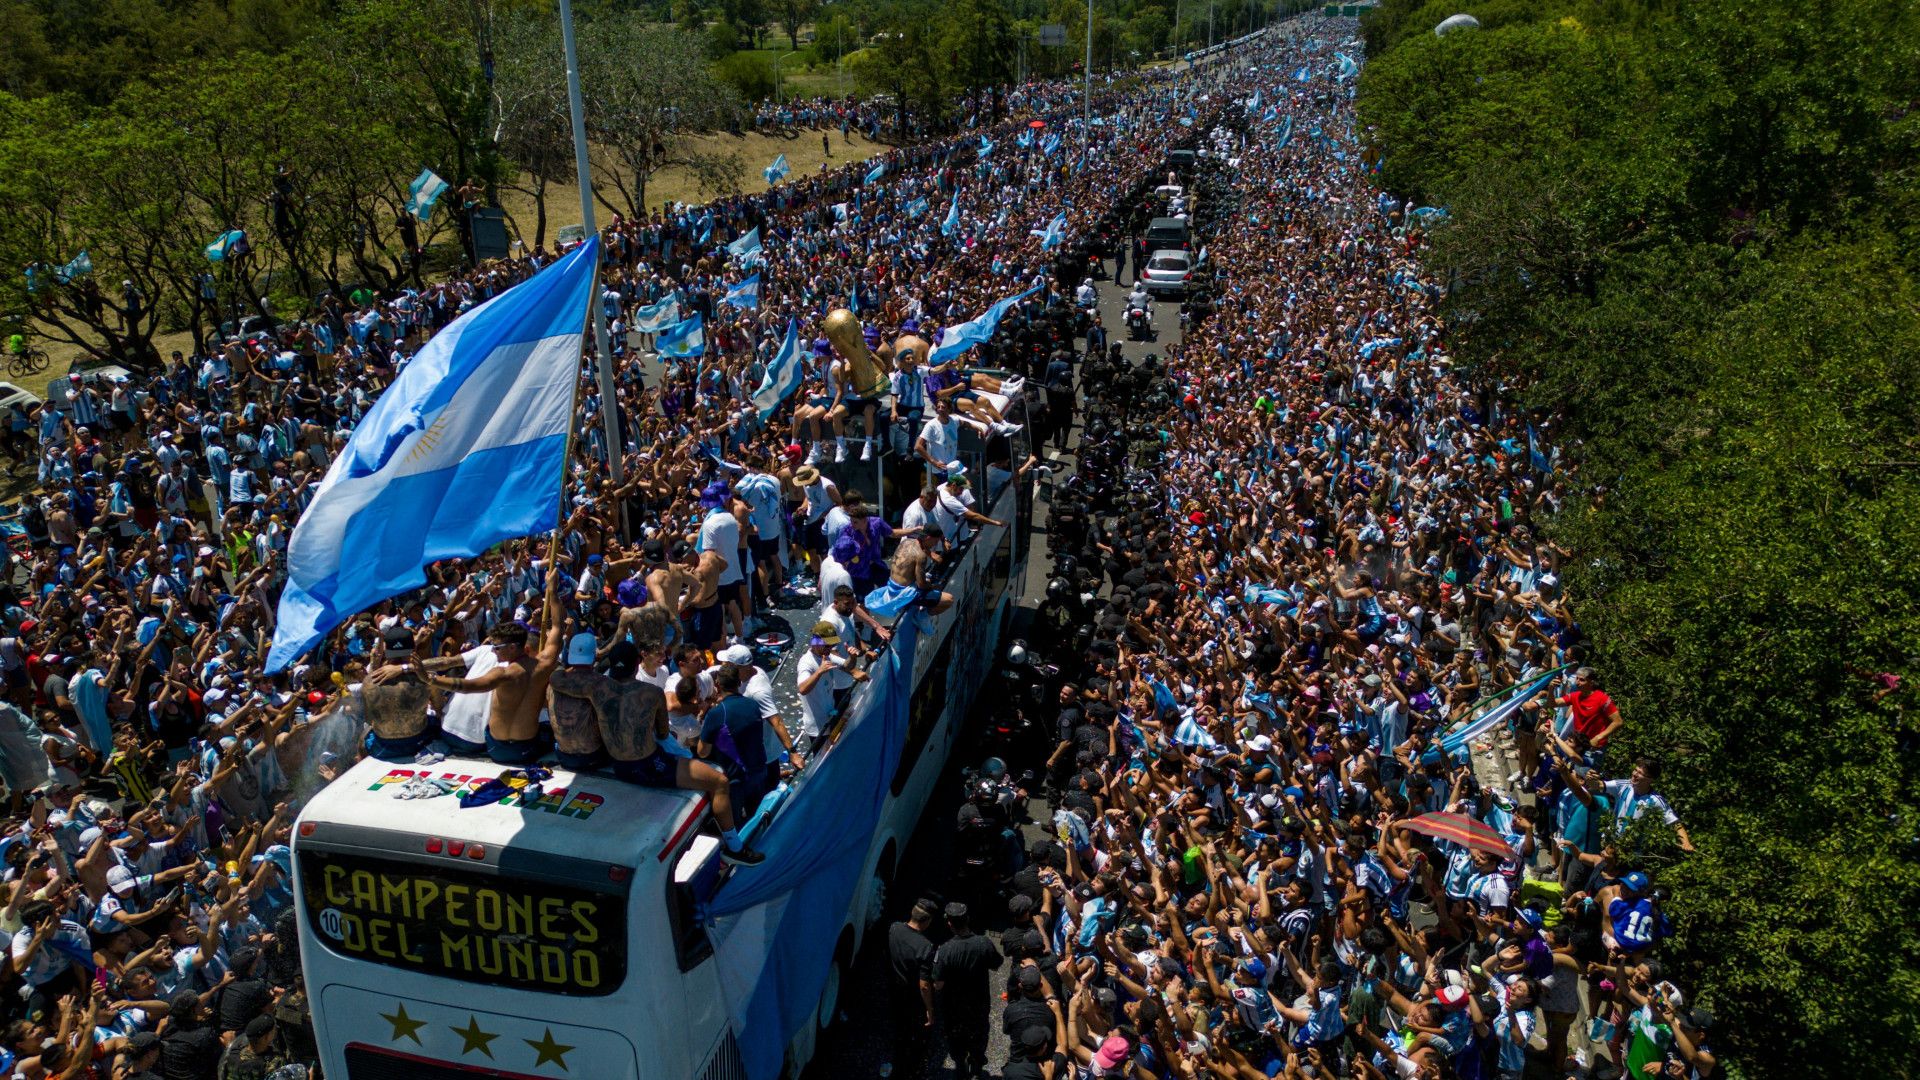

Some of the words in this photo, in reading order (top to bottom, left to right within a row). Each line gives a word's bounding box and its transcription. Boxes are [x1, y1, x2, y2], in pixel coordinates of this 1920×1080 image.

[324, 864, 598, 943] CAMPEONES
[1624, 911, 1653, 941] 10
[341, 912, 423, 962] DEL
[440, 930, 600, 988] MUNDO
